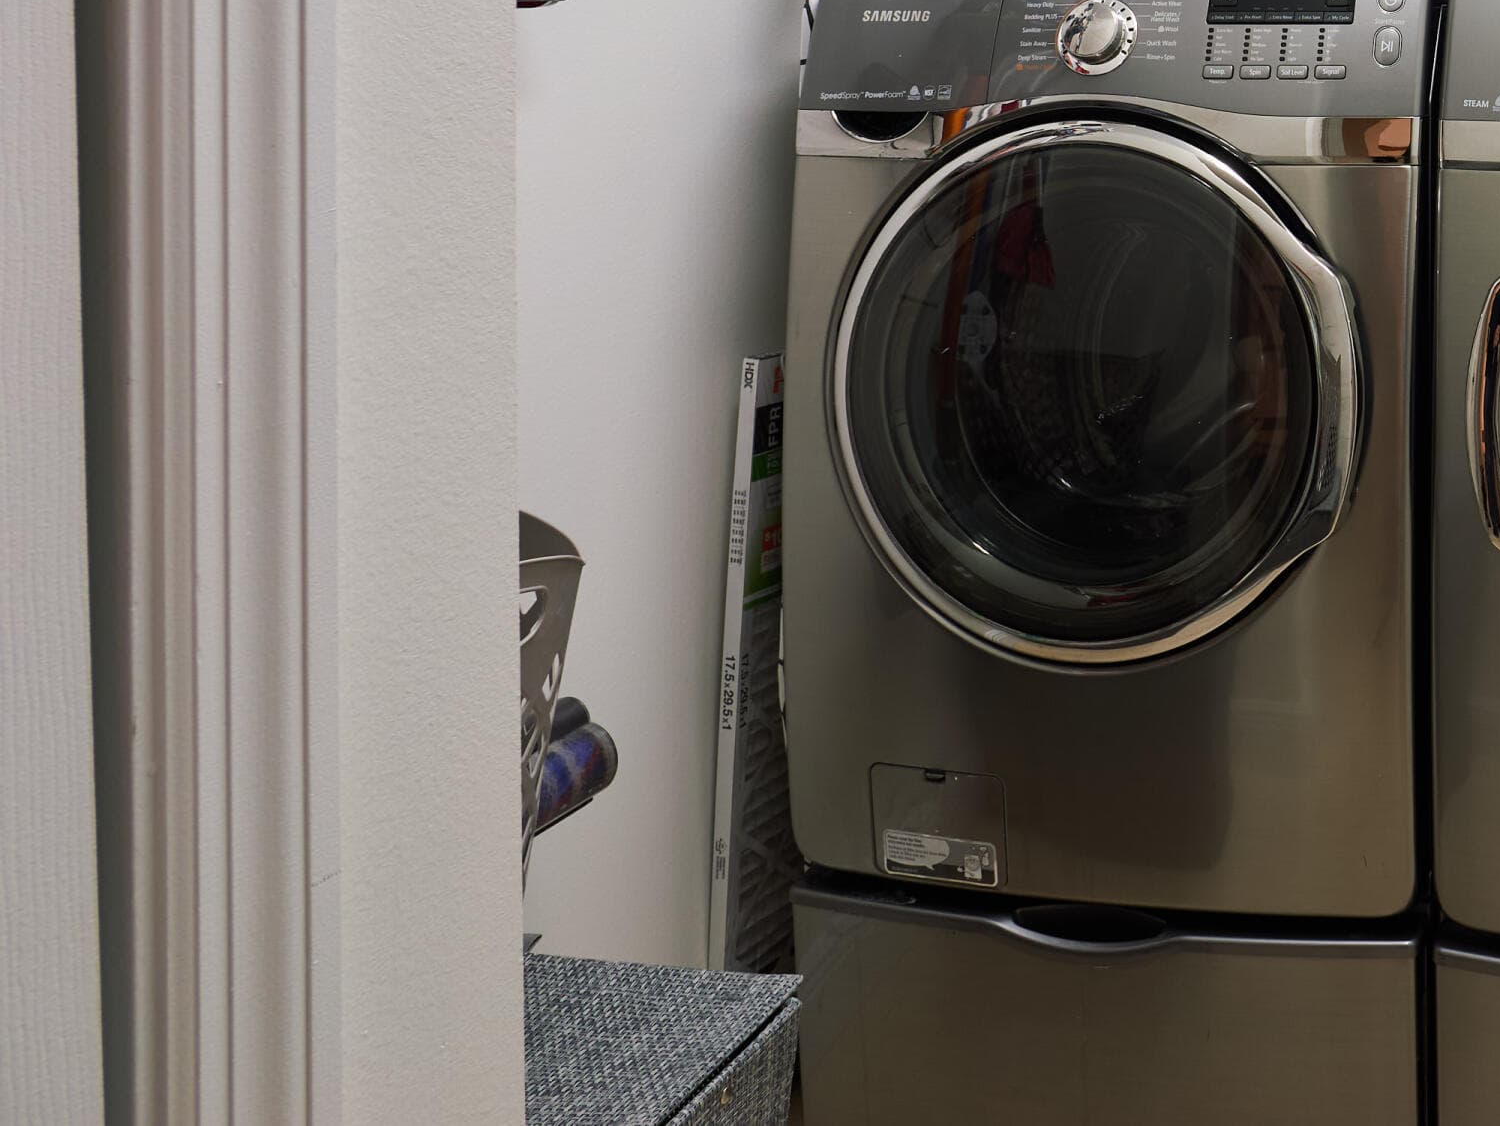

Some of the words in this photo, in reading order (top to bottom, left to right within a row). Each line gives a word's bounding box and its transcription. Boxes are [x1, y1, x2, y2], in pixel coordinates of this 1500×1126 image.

[862, 10, 930, 22] SAMSUNG
[1323, 68, 1339, 76] Signal
[1464, 99, 1488, 107] STEAM
[744, 362, 754, 389] HDX
[769, 406, 781, 447] FPR
